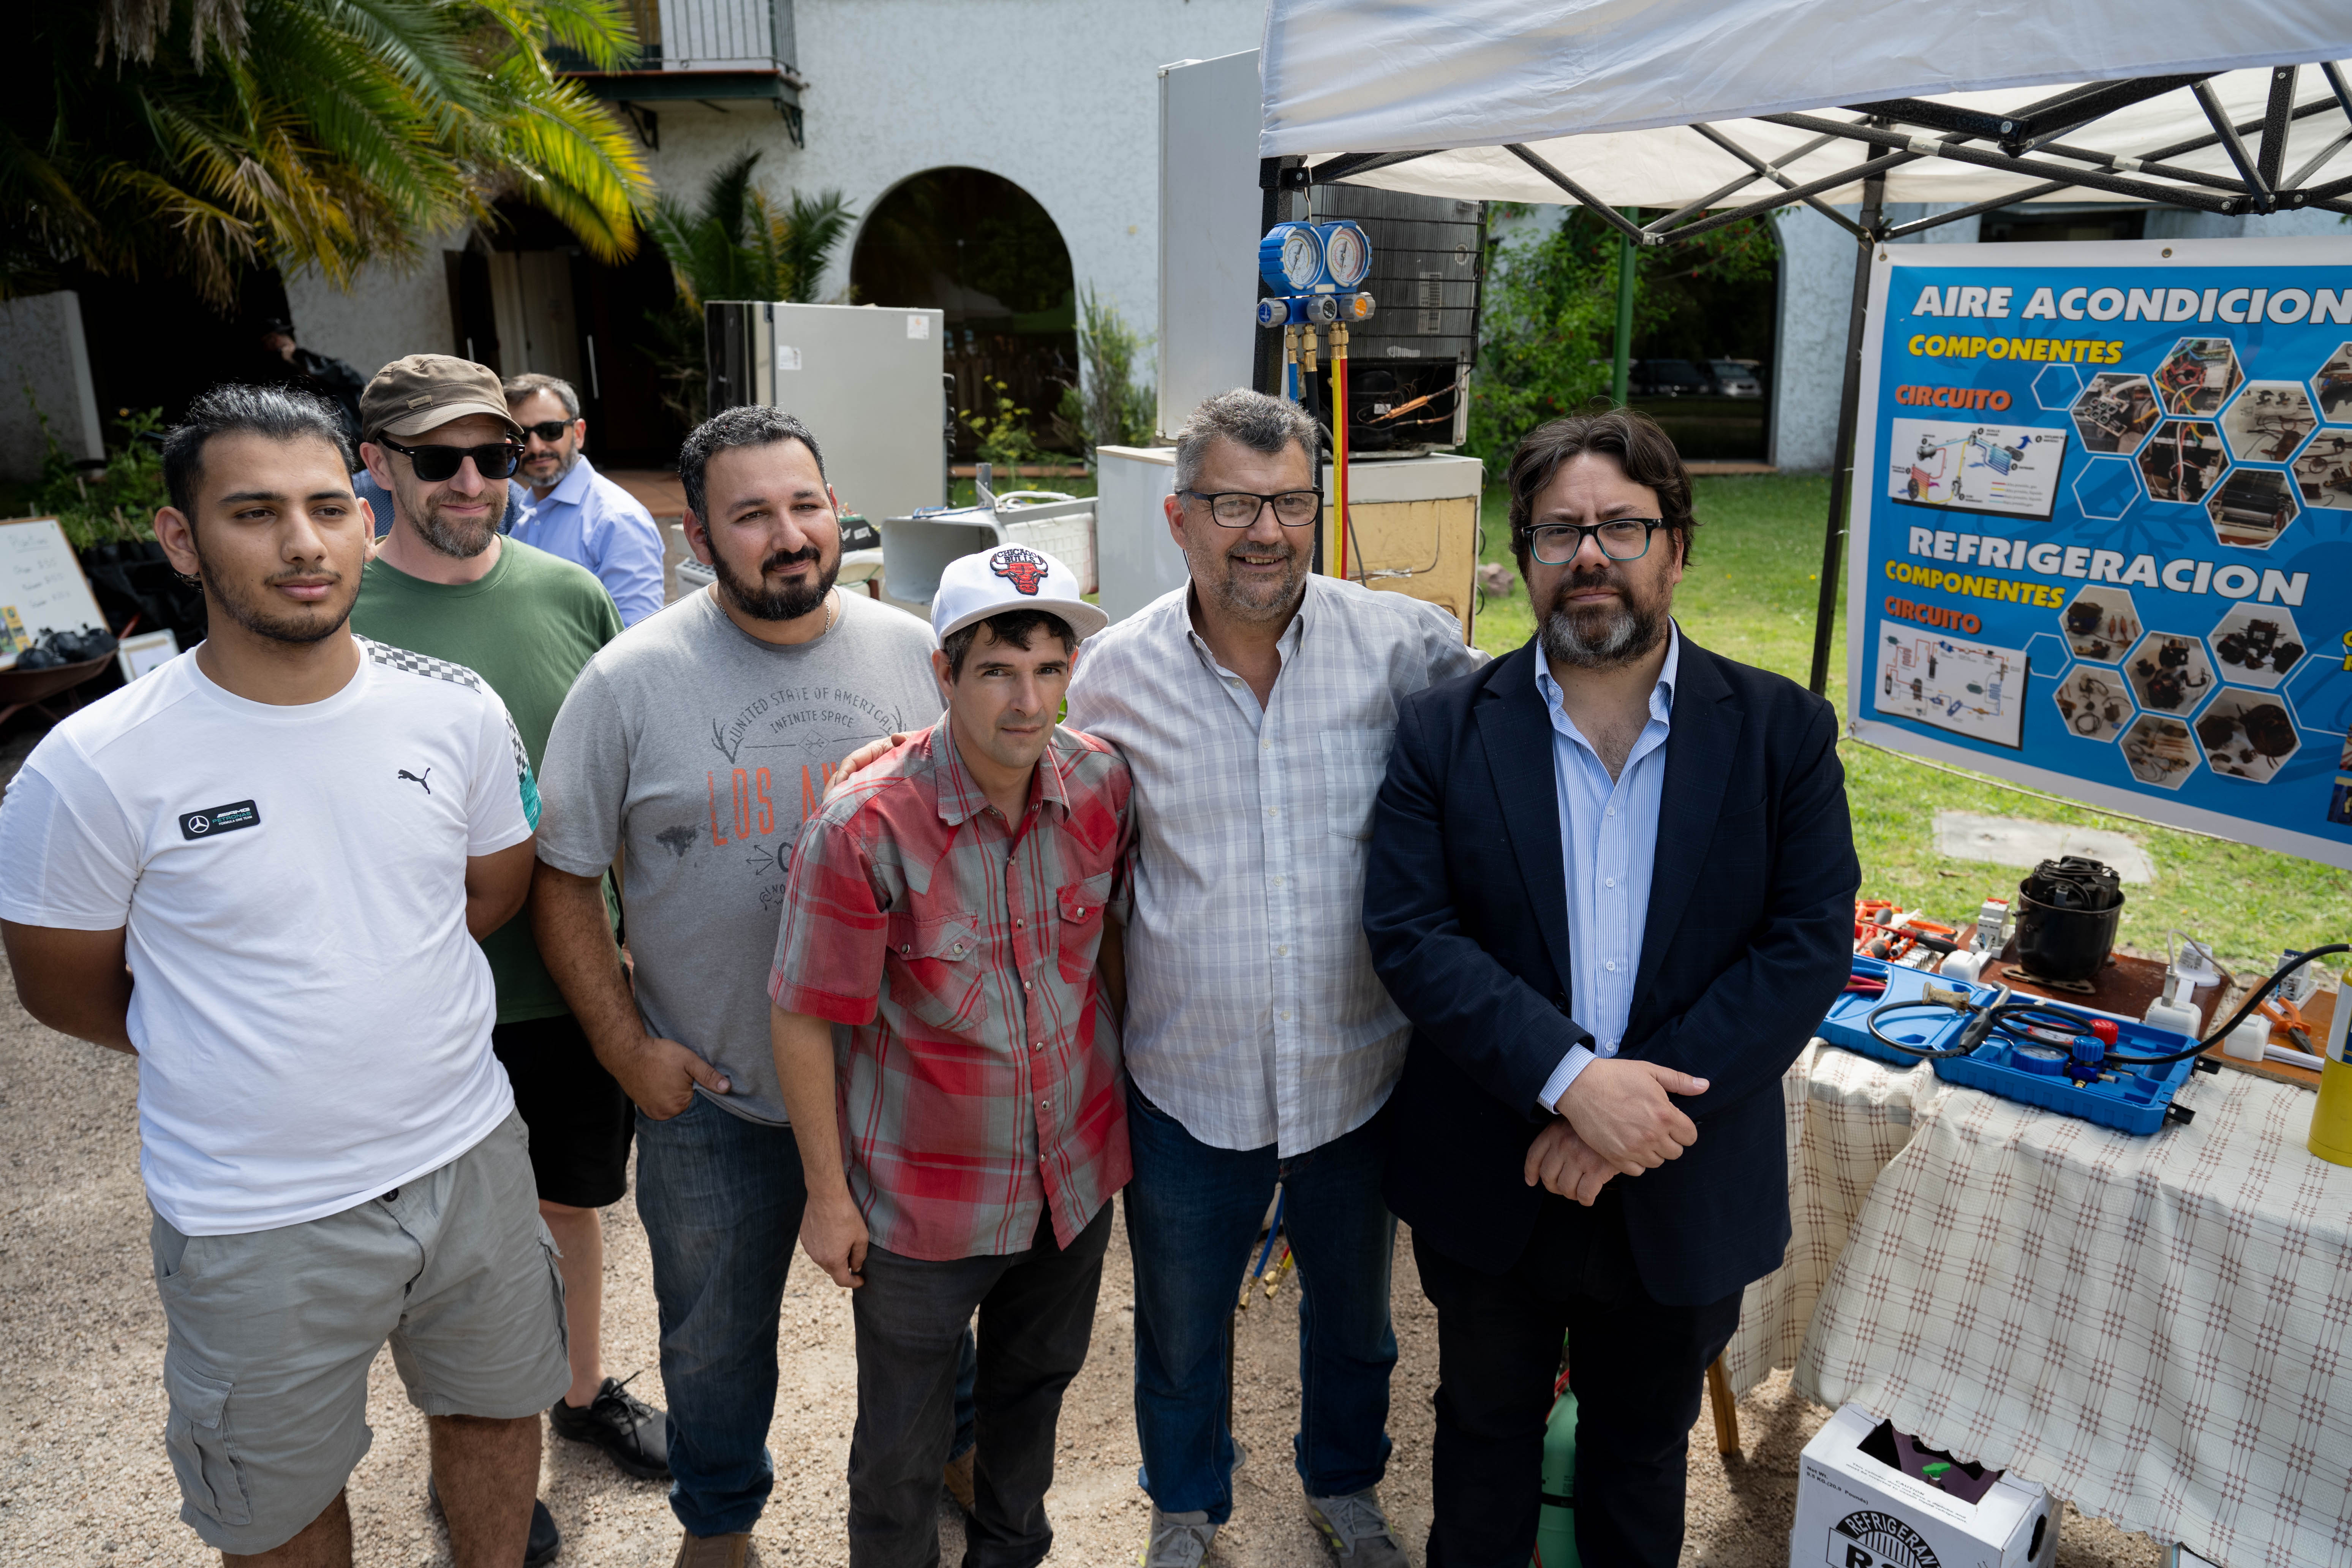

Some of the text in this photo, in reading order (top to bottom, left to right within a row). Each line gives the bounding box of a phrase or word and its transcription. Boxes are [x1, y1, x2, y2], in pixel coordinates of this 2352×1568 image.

[1912, 285, 2013, 318] AIRE
[1908, 334, 2124, 364] COMPONENTES
[1895, 385, 2012, 411] CIRCUITO
[997, 548, 1037, 558] CHICAGO
[1909, 526, 2309, 607] REFRIGERACION
[1885, 560, 2065, 609] COMPONENTES
[1884, 596, 1981, 634] CIRCUITO
[730, 687, 891, 738] UNITED STATE OF AMERICA
[770, 710, 855, 734] INFINITE SPACE
[212, 811, 251, 824] PETRONAS
[707, 767, 775, 846] LOS
[1845, 1490, 1868, 1505] Pounds)
[1895, 1480, 1925, 1495] CAUTION
